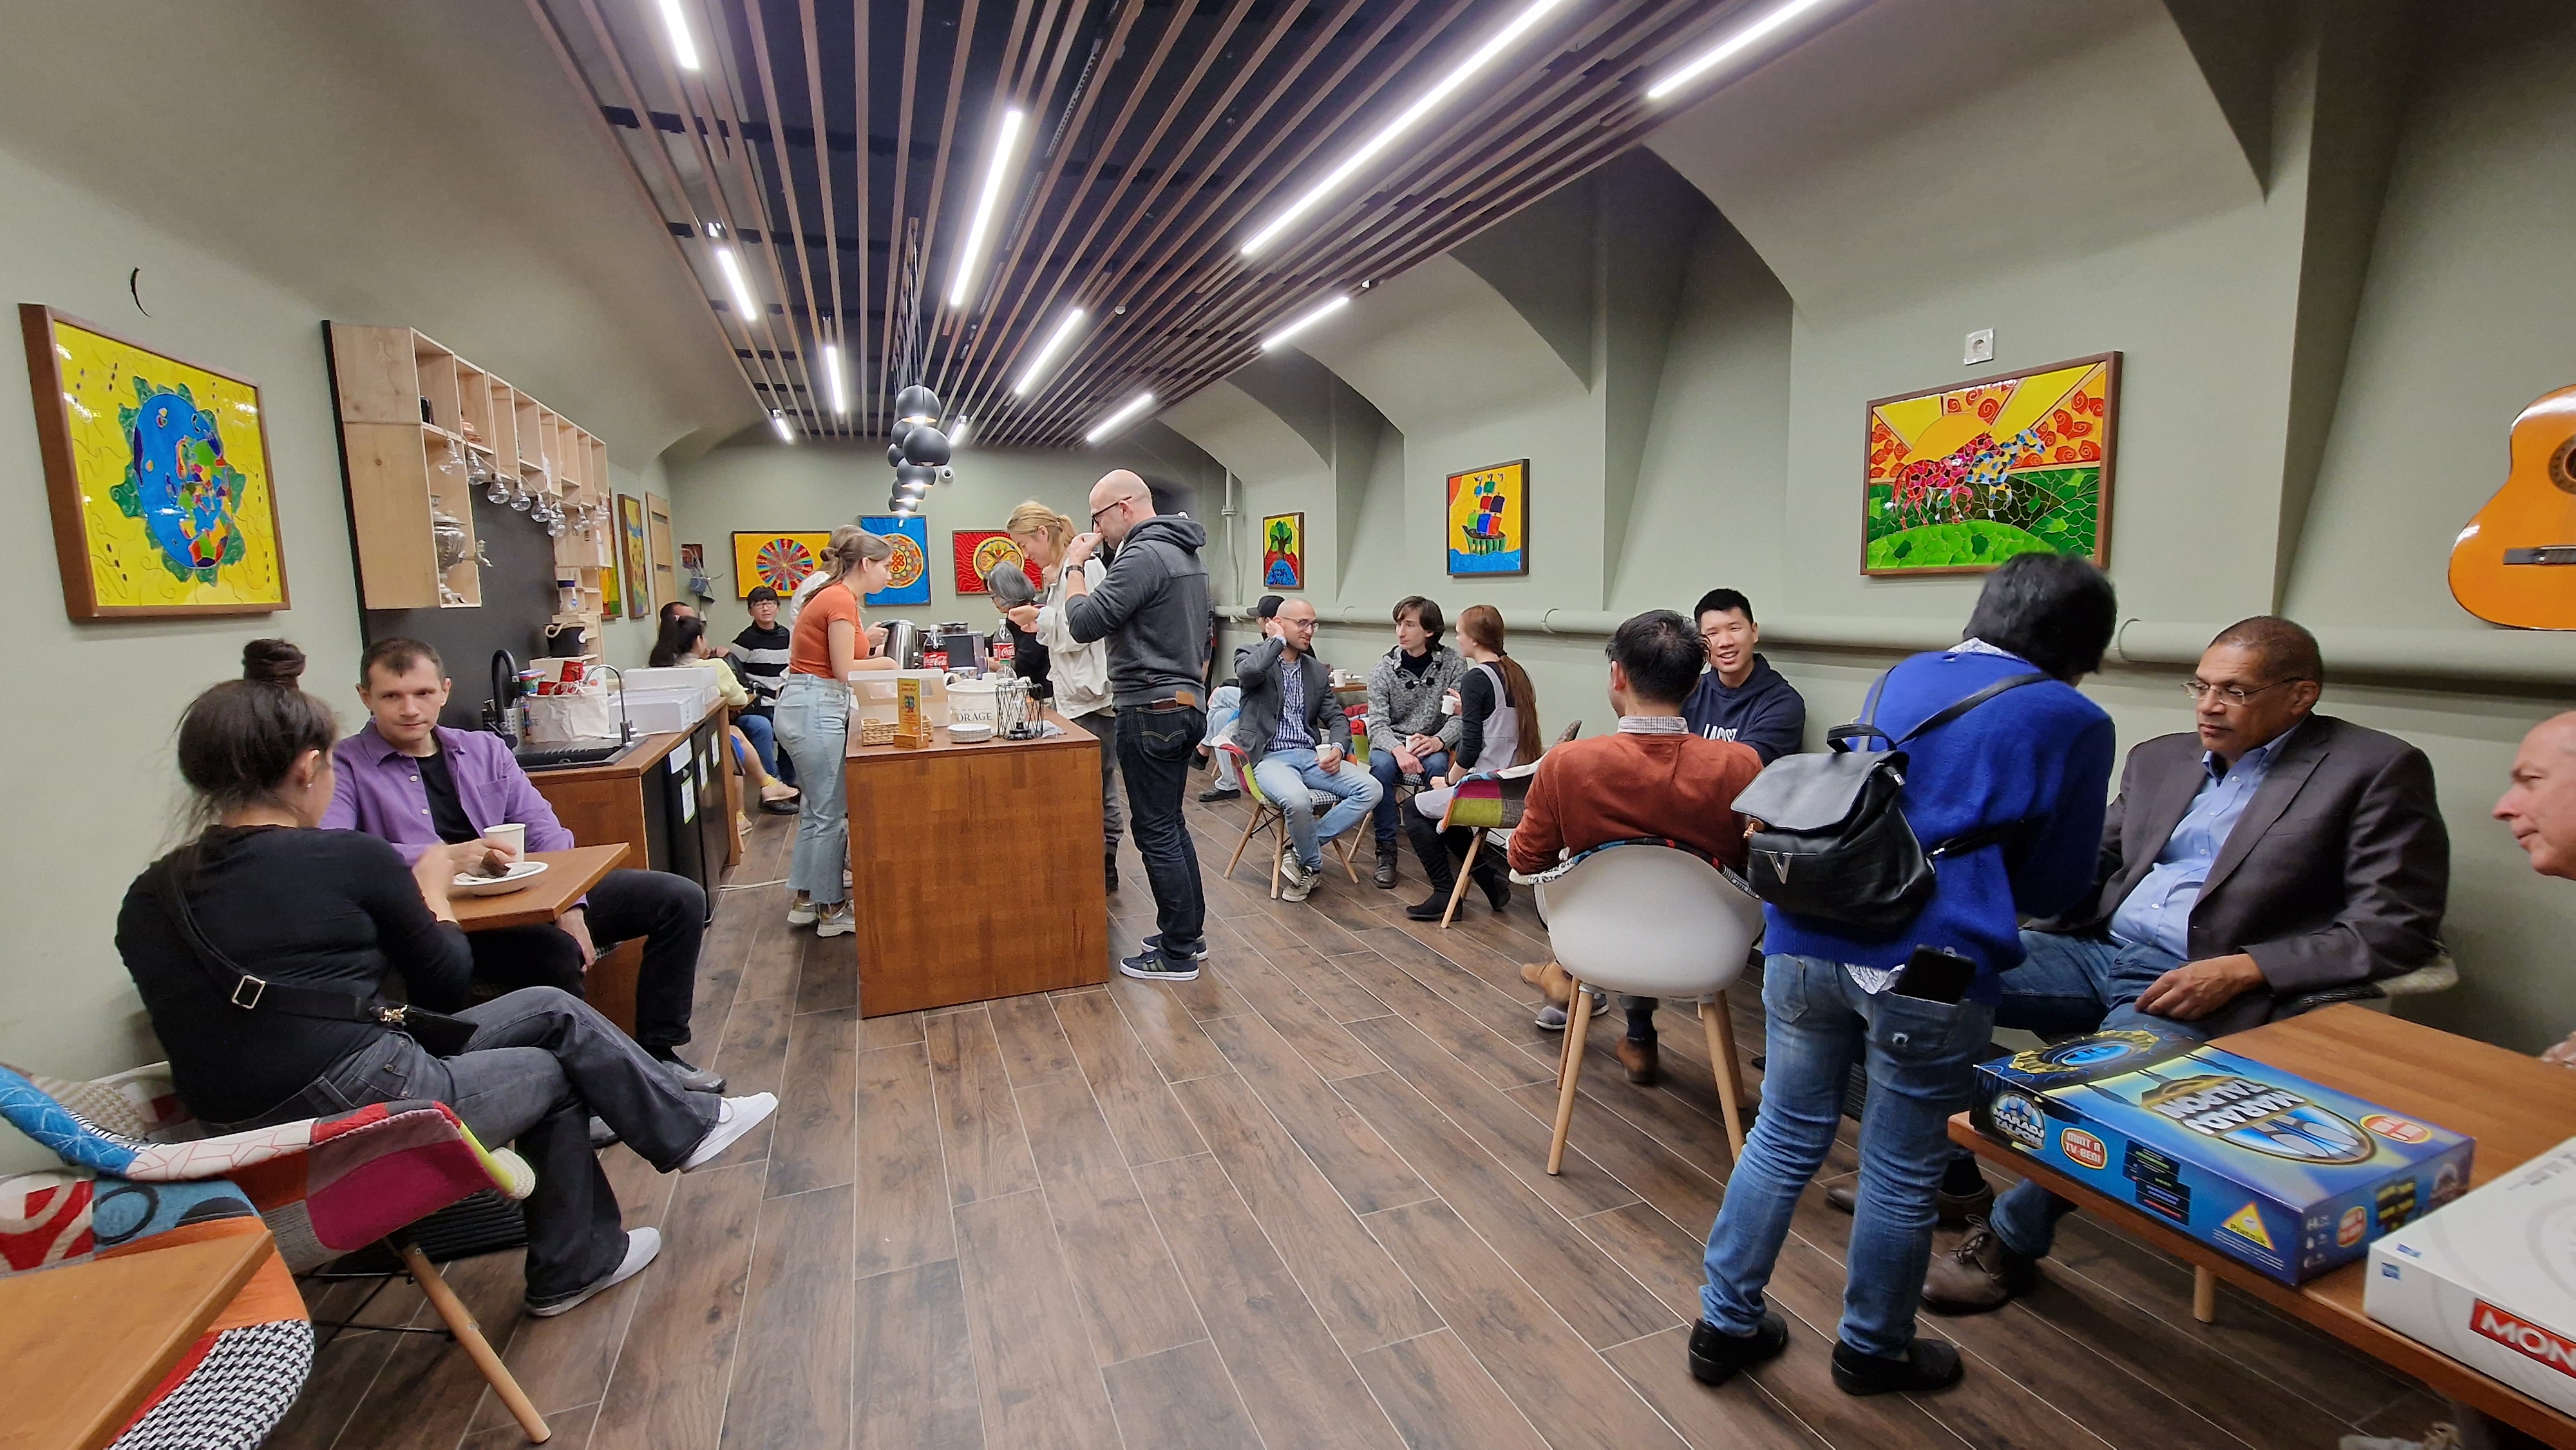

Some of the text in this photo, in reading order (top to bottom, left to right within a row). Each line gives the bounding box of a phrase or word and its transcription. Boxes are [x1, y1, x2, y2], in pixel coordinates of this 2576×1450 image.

[954, 712, 992, 722] ORAGE
[2151, 1078, 2268, 1119] TALPON
[2182, 1089, 2306, 1135] MARADJ
[1993, 1107, 2045, 1138] MARADJ
